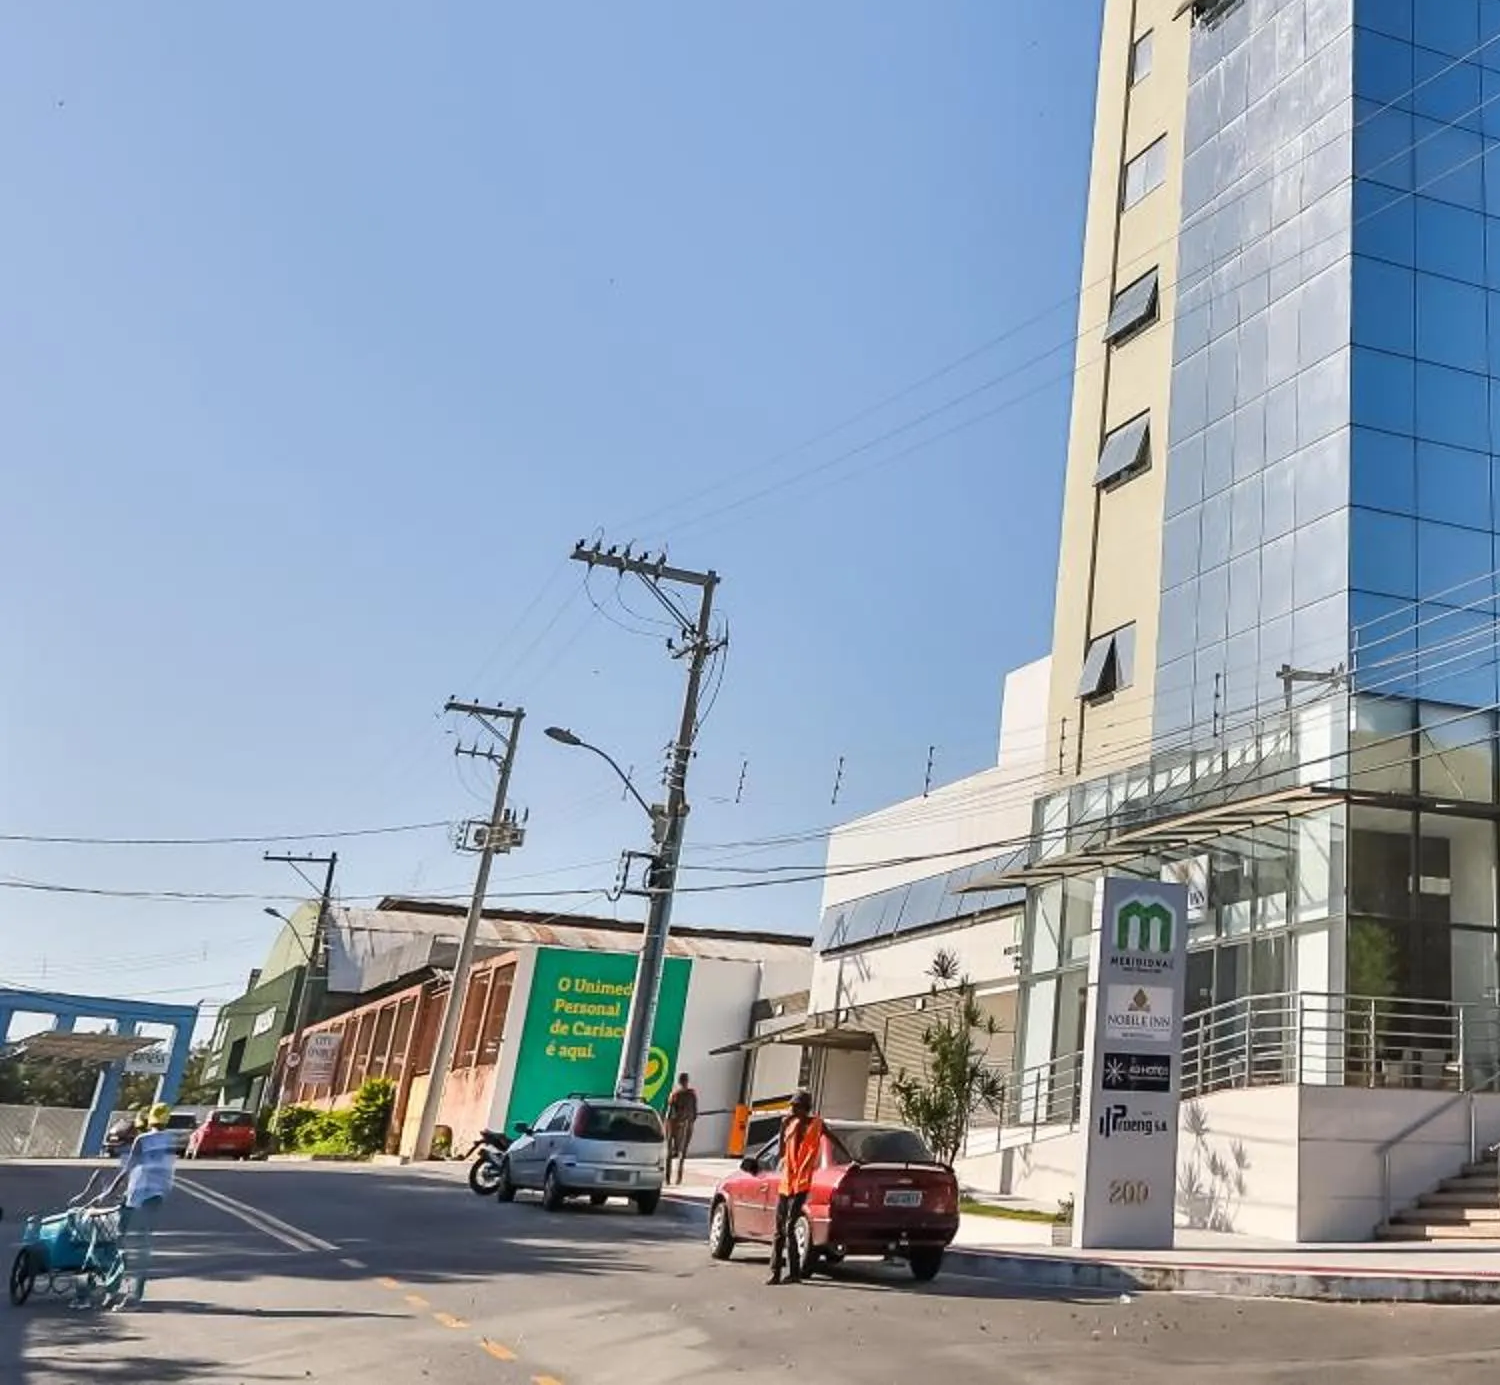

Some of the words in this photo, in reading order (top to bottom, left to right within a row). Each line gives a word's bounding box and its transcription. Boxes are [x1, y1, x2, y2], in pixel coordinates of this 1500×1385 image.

[1110, 956, 1175, 970] MERIDIONAL
[558, 977, 572, 992] O
[575, 977, 636, 996] Unimed
[554, 998, 621, 1016] Personal
[550, 1019, 569, 1035] de
[572, 1021, 626, 1038] Cariac
[1108, 1014, 1149, 1027] NOBILE
[1150, 1017, 1170, 1028] INN
[545, 1040, 557, 1056] é
[1109, 1179, 1150, 1206] 200
